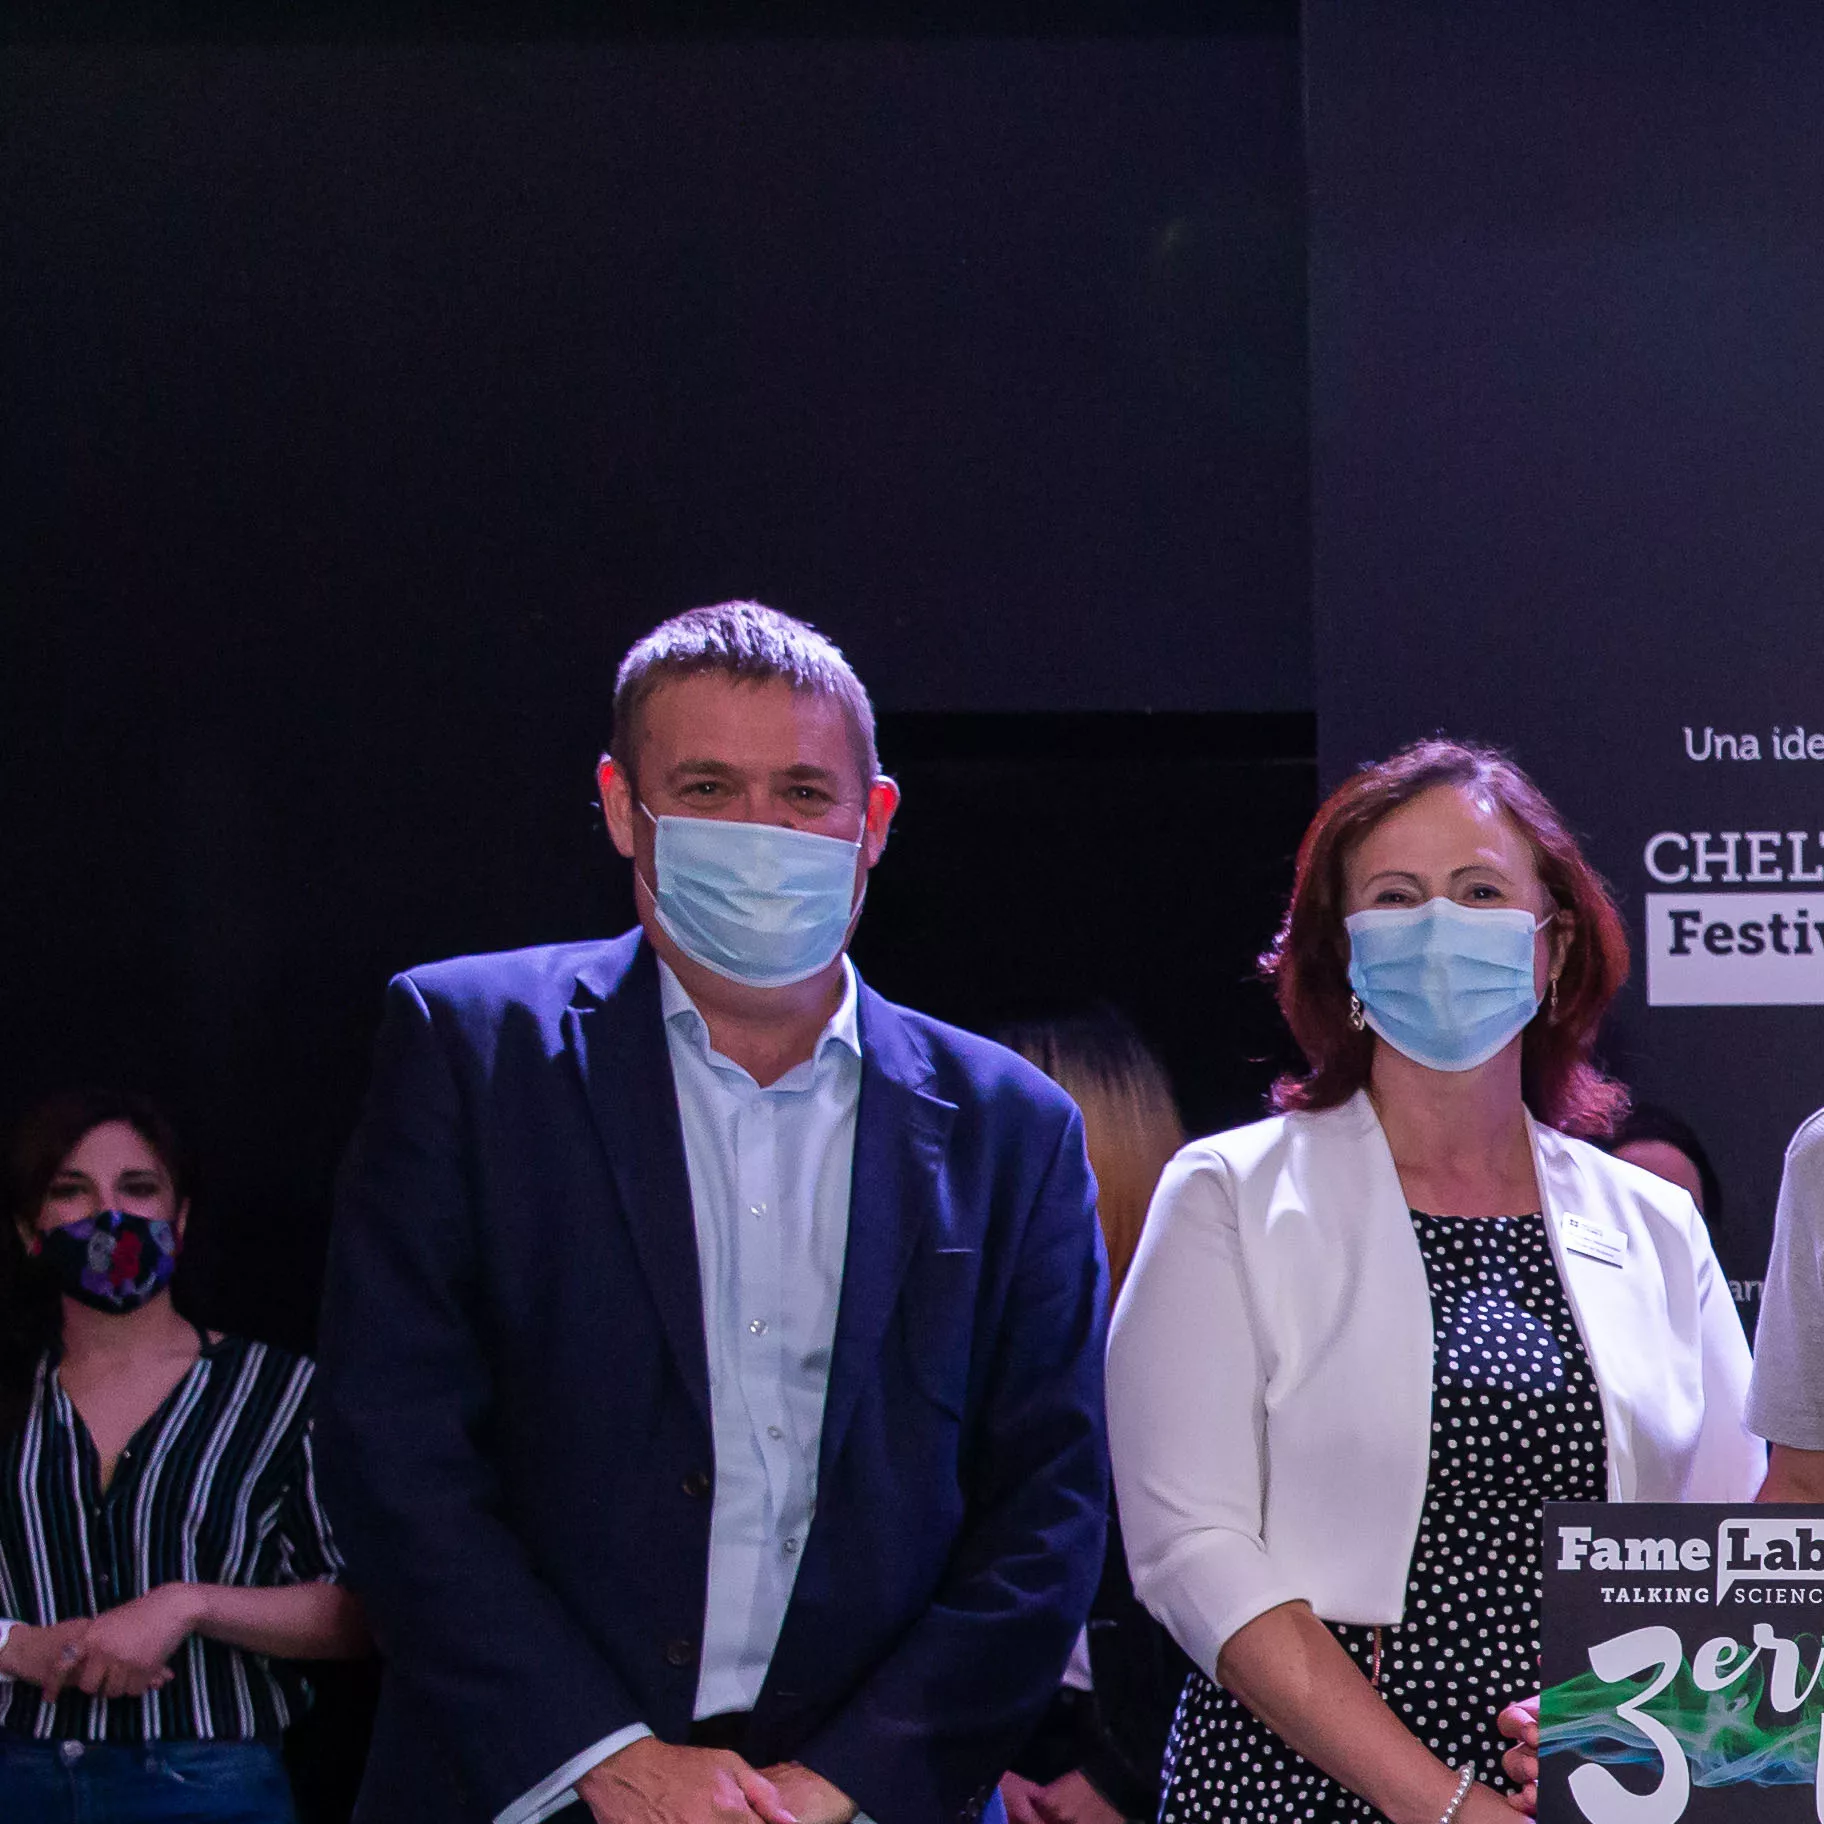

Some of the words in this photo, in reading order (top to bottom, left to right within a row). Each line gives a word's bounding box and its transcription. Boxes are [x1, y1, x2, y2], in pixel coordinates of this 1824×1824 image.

[1685, 726, 1761, 761] Una
[1557, 1526, 1711, 1571] Fame
[1601, 1587, 1709, 1604] TALKING
